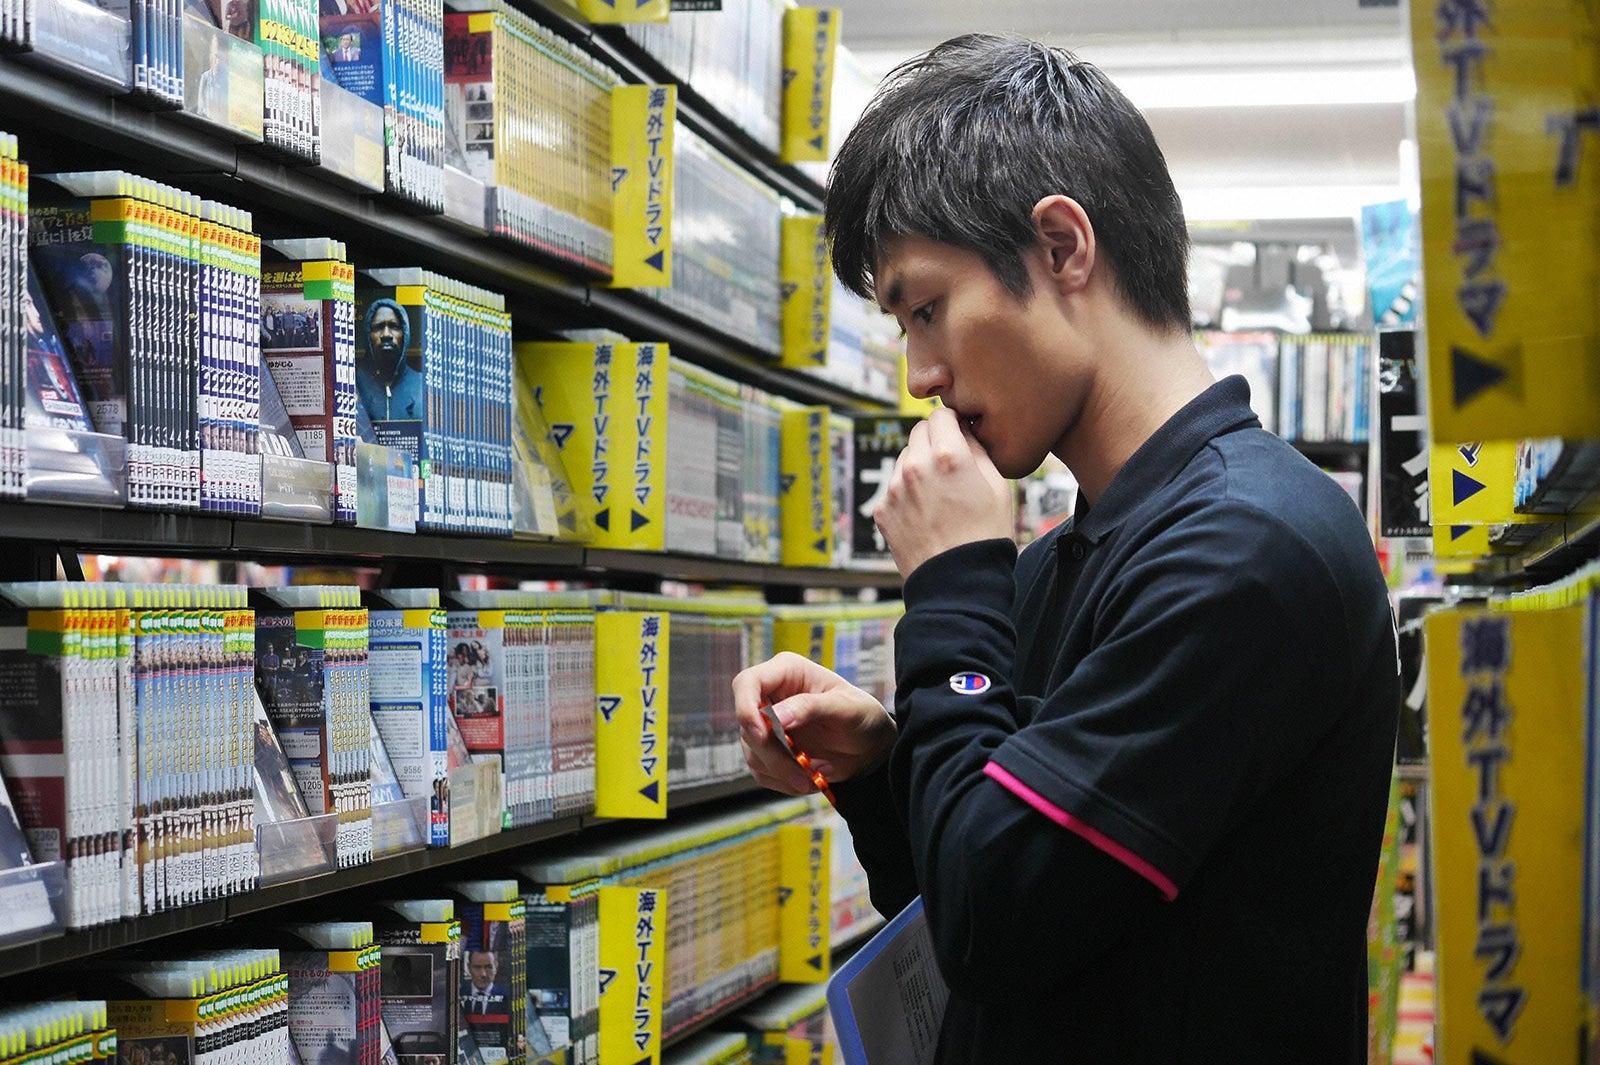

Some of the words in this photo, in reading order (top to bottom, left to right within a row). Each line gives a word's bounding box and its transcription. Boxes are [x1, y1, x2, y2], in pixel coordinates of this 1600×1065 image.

[645, 87, 667, 246] 海外TVドラマ
[96, 404, 119, 414] 2578
[304, 431, 323, 440] 1185
[552, 424, 575, 451] マ
[592, 345, 612, 505] 海外TVドラマ
[635, 345, 655, 506] 海外TVドラマ
[190, 471, 197, 482] R
[599, 696, 622, 722] マ
[640, 616, 662, 777] 海外TVドラマ
[303, 781, 322, 790] 1205
[1459, 617, 1530, 1043] 海外TVドラマ
[633, 891, 657, 1052] 海外TVドラマ
